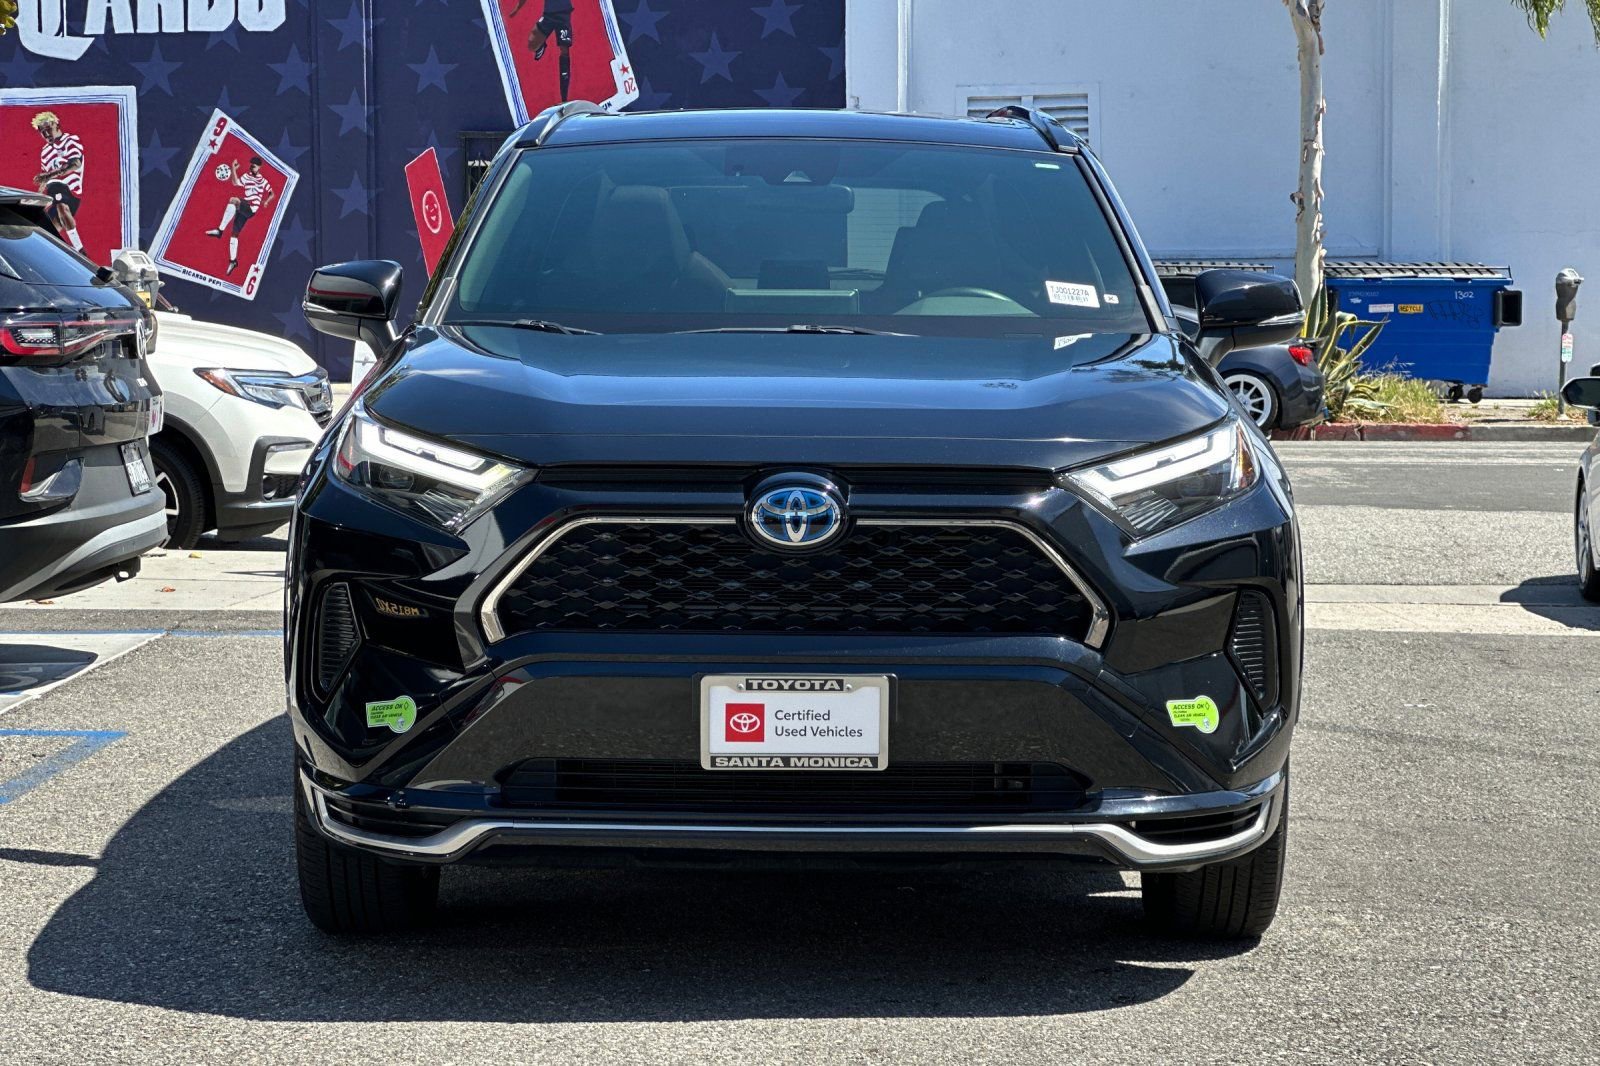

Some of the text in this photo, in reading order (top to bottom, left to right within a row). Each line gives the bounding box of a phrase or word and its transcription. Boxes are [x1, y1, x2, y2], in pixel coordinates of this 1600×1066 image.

[213, 117, 228, 137] 9
[208, 278, 222, 287] PEPI
[1454, 290, 1475, 299] 1302
[748, 680, 841, 690] TOYOTA
[774, 709, 831, 721] Certified
[774, 725, 863, 738] Used Vehicles
[715, 756, 873, 768] SANTA MONICA
